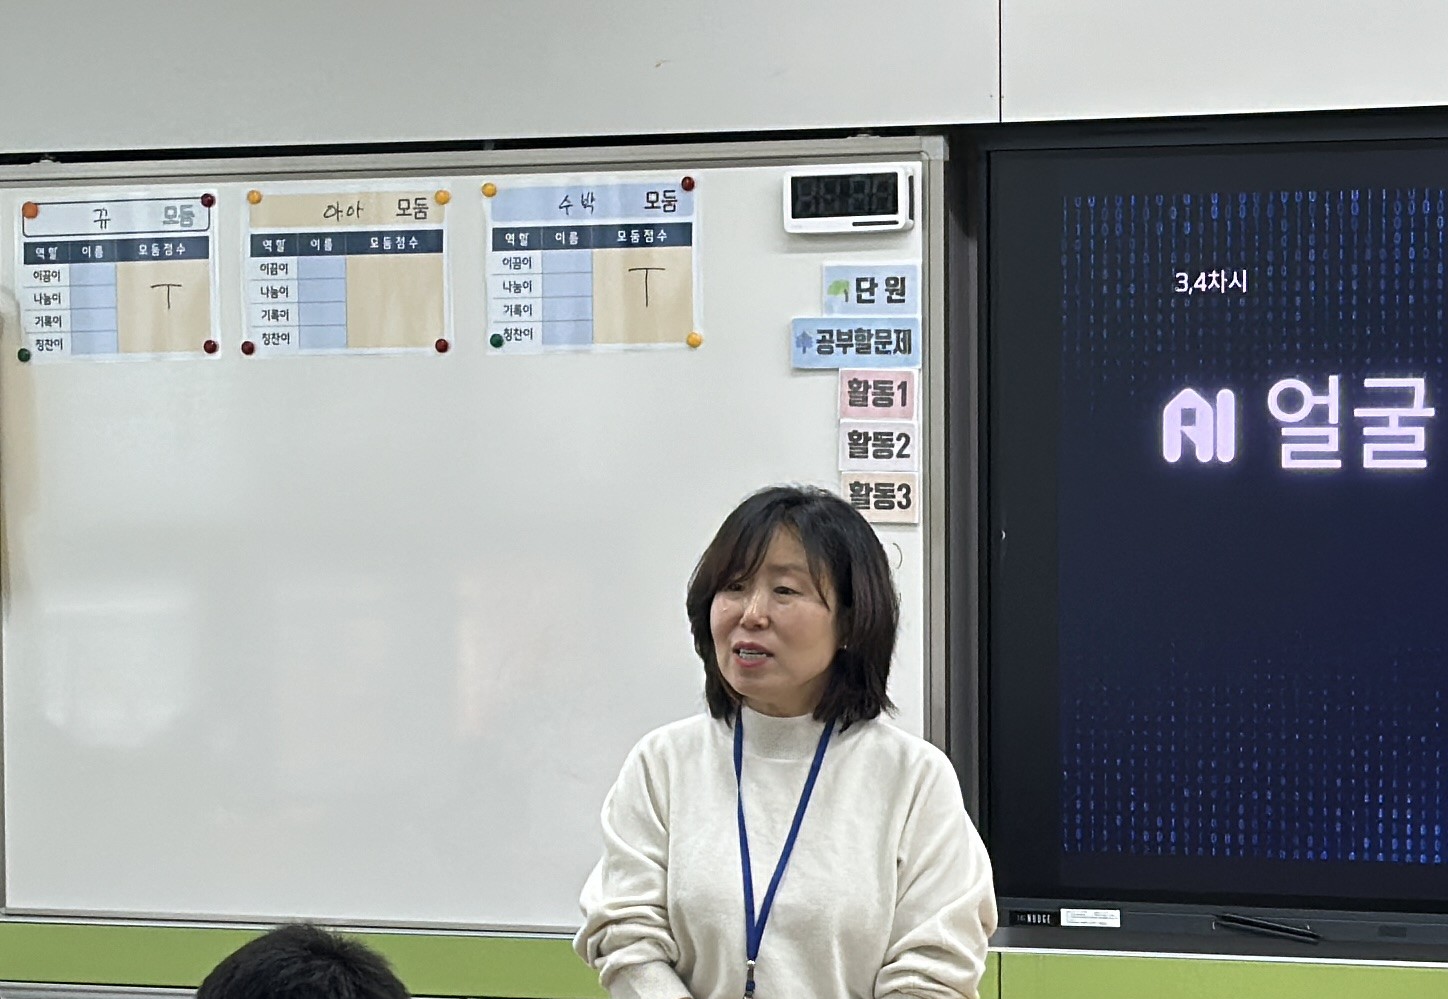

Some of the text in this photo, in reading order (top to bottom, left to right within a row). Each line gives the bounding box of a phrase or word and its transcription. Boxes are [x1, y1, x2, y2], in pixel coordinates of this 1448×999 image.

[396, 197, 429, 220] 모둠
[644, 190, 678, 213] 모둠
[1174, 269, 1248, 294] 3,4차시
[815, 327, 912, 355] 공부할문제
[847, 378, 907, 408] 활동1
[1162, 388, 1235, 463] AI
[1267, 375, 1436, 469] 얼굴
[847, 429, 911, 459] 활동2
[849, 481, 912, 510] 활동3
